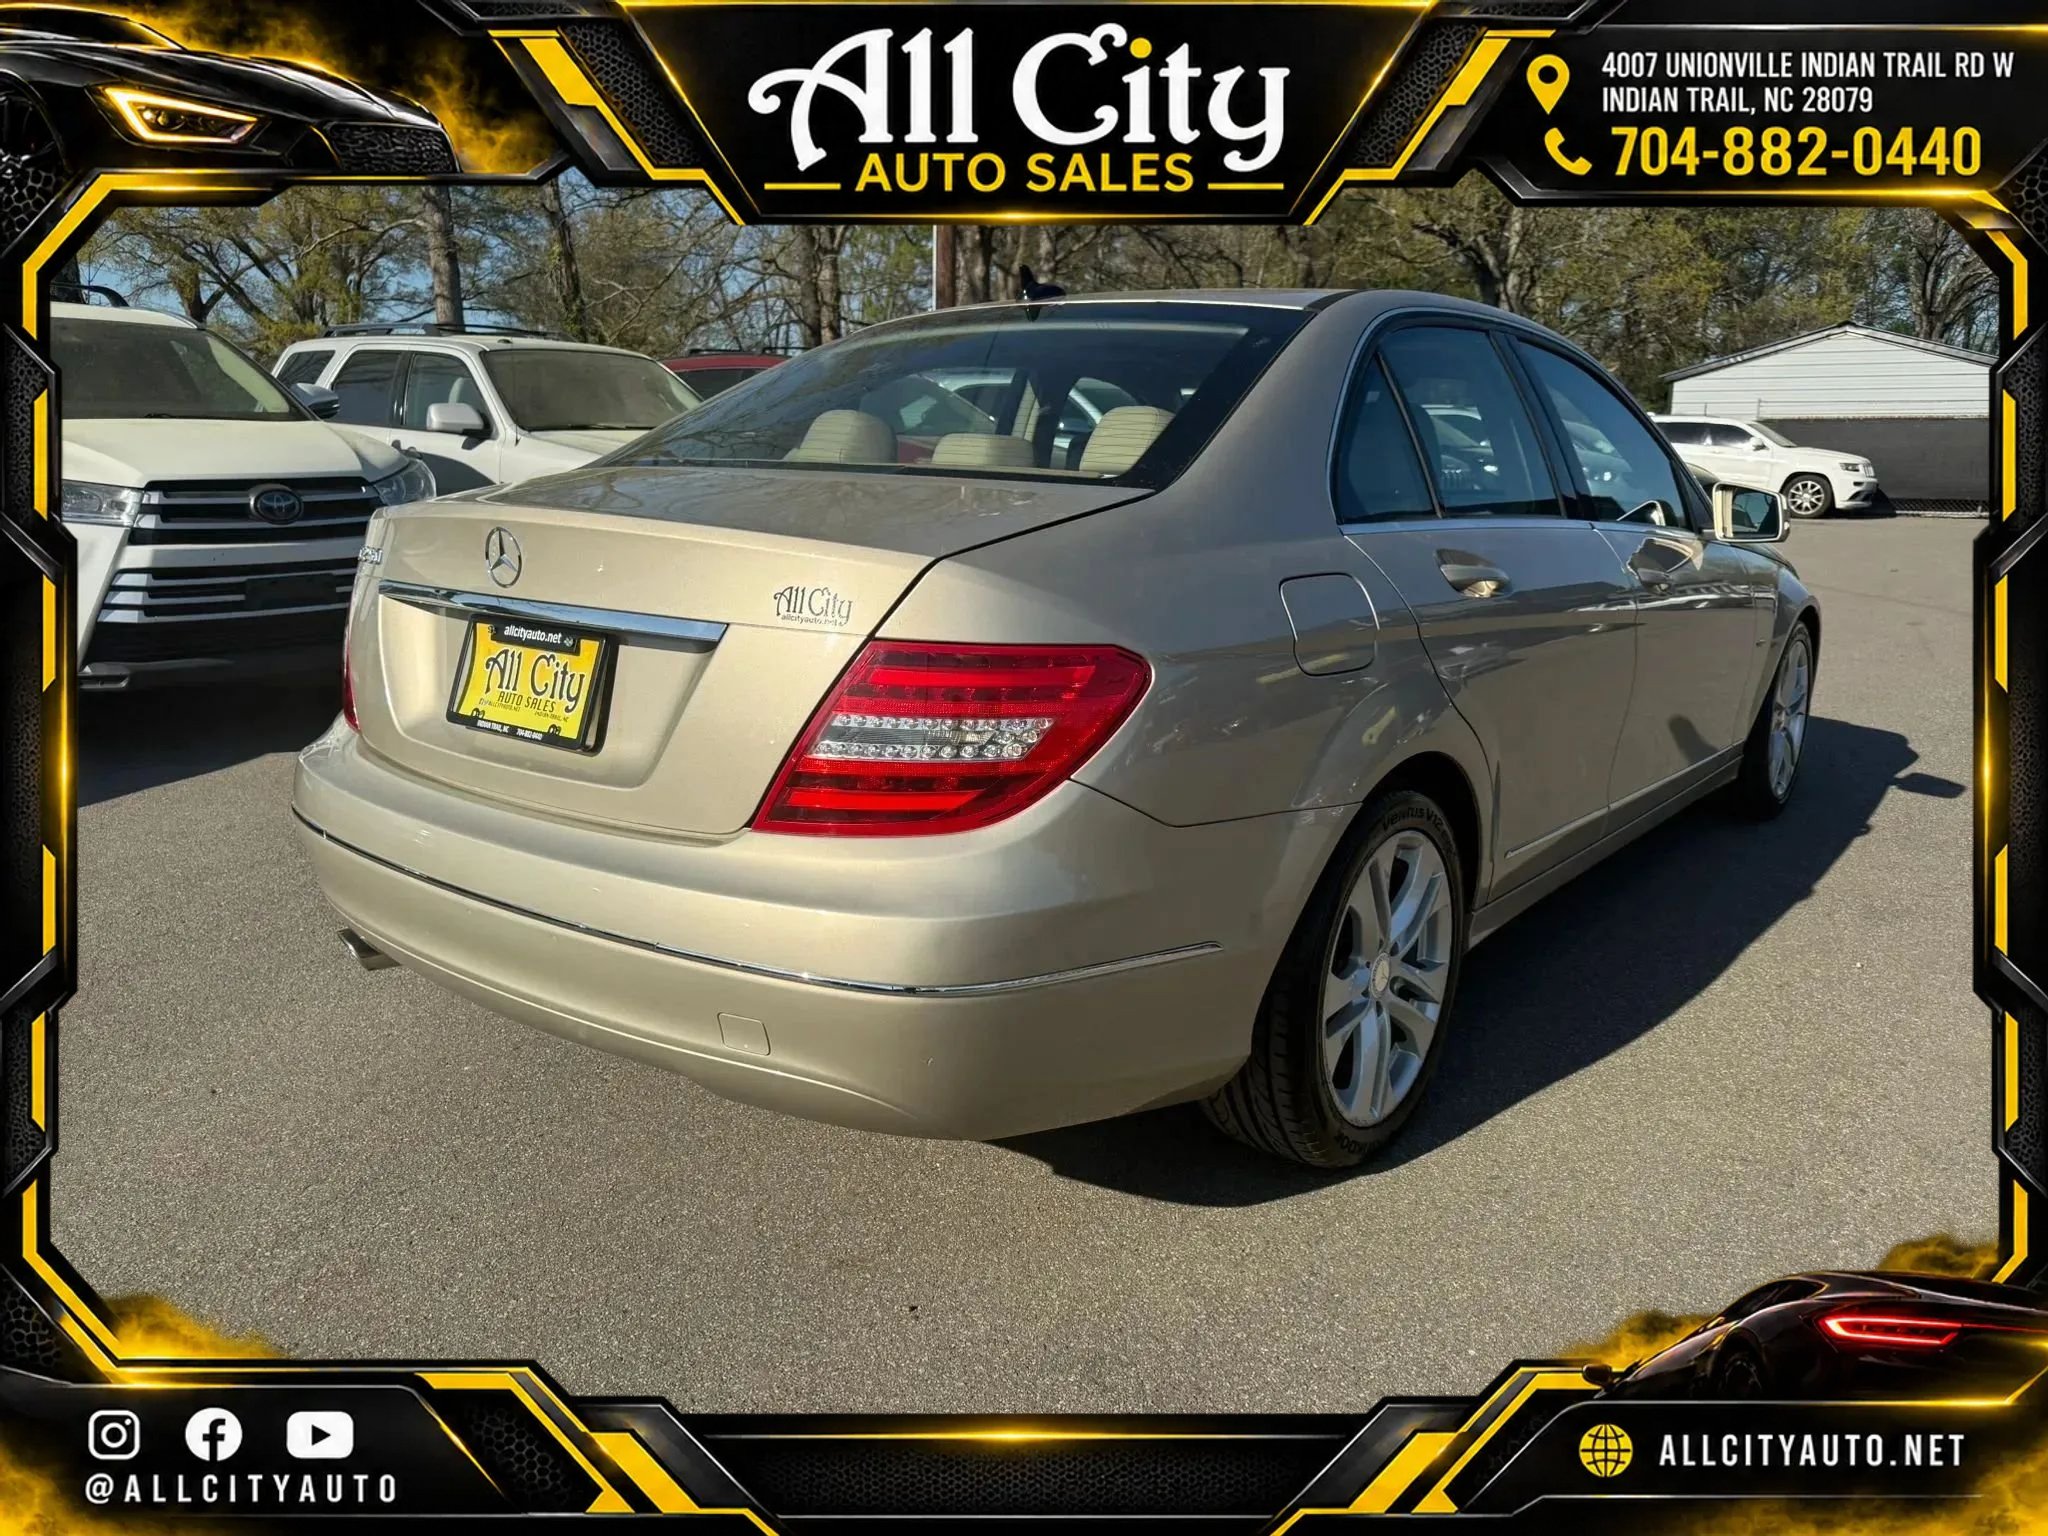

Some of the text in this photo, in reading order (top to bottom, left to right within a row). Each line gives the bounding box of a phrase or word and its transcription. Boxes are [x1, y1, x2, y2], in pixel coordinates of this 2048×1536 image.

[773, 586, 853, 626] All City
[503, 625, 563, 644] allcityauto.net
[485, 648, 586, 713] All City
[497, 691, 557, 713] AUTO SALES
